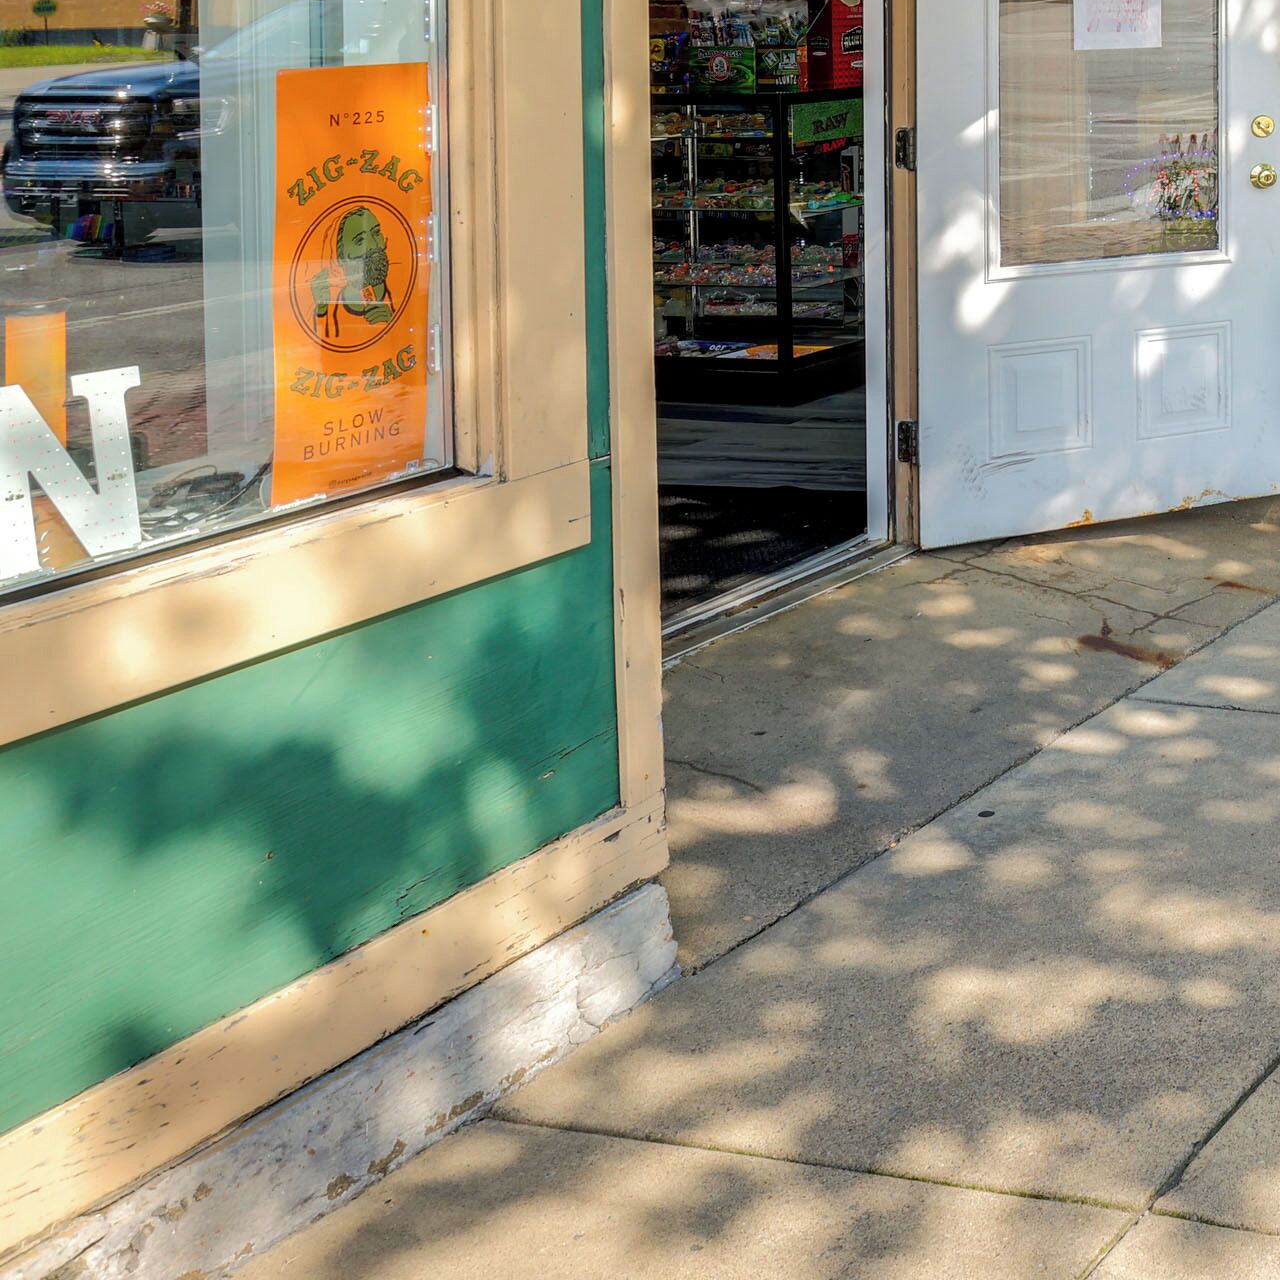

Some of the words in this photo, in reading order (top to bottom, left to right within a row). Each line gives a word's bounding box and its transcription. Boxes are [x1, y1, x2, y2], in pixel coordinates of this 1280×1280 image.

[812, 111, 849, 136] RAW
[822, 137, 847, 153] RAW
[287, 149, 424, 206] ZIG-ZAG
[290, 344, 417, 399] ZIG-ZAG
[323, 407, 384, 437] SLOW
[303, 422, 400, 461] BURNING
